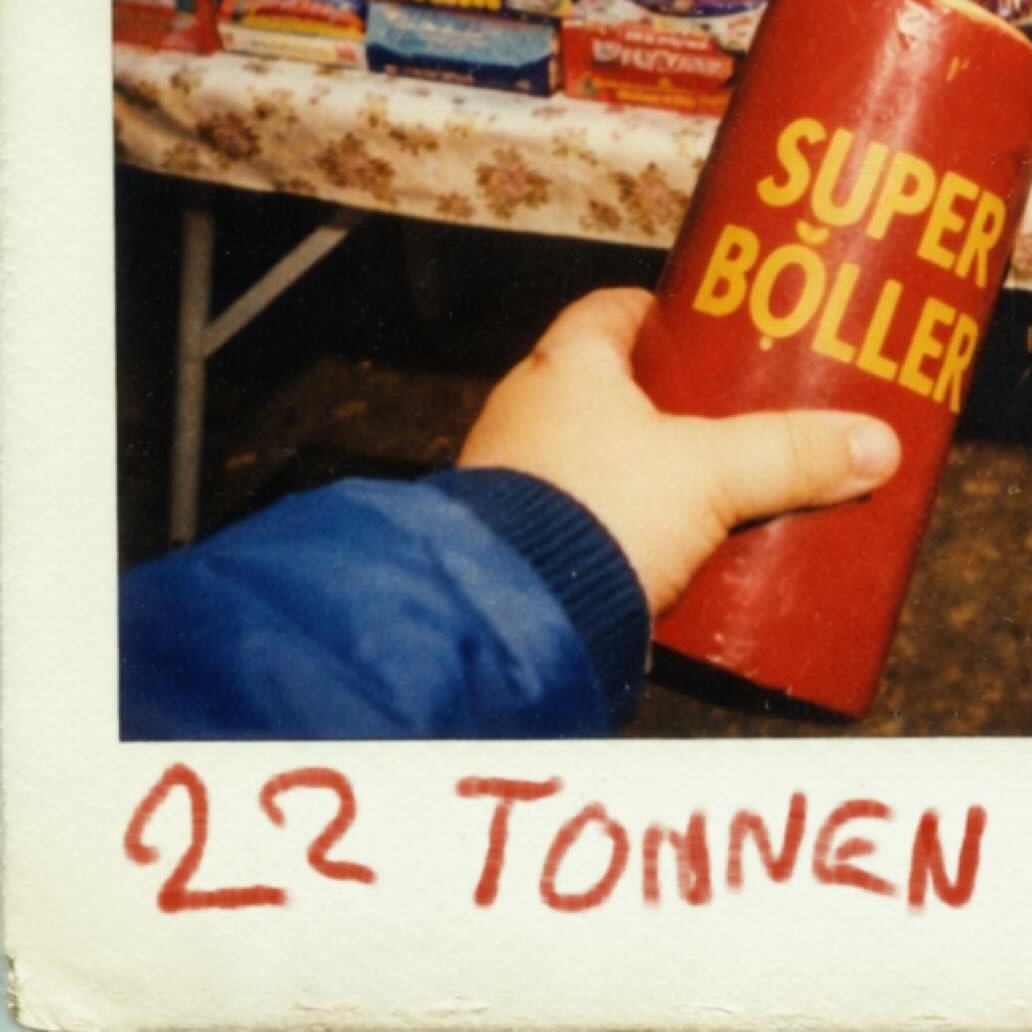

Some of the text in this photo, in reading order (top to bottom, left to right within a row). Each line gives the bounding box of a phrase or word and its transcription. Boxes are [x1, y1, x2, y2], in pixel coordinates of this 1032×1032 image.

[757, 118, 1006, 288] SUPER
[124, 764, 375, 913] 22
[457, 778, 986, 912] TONNEN
